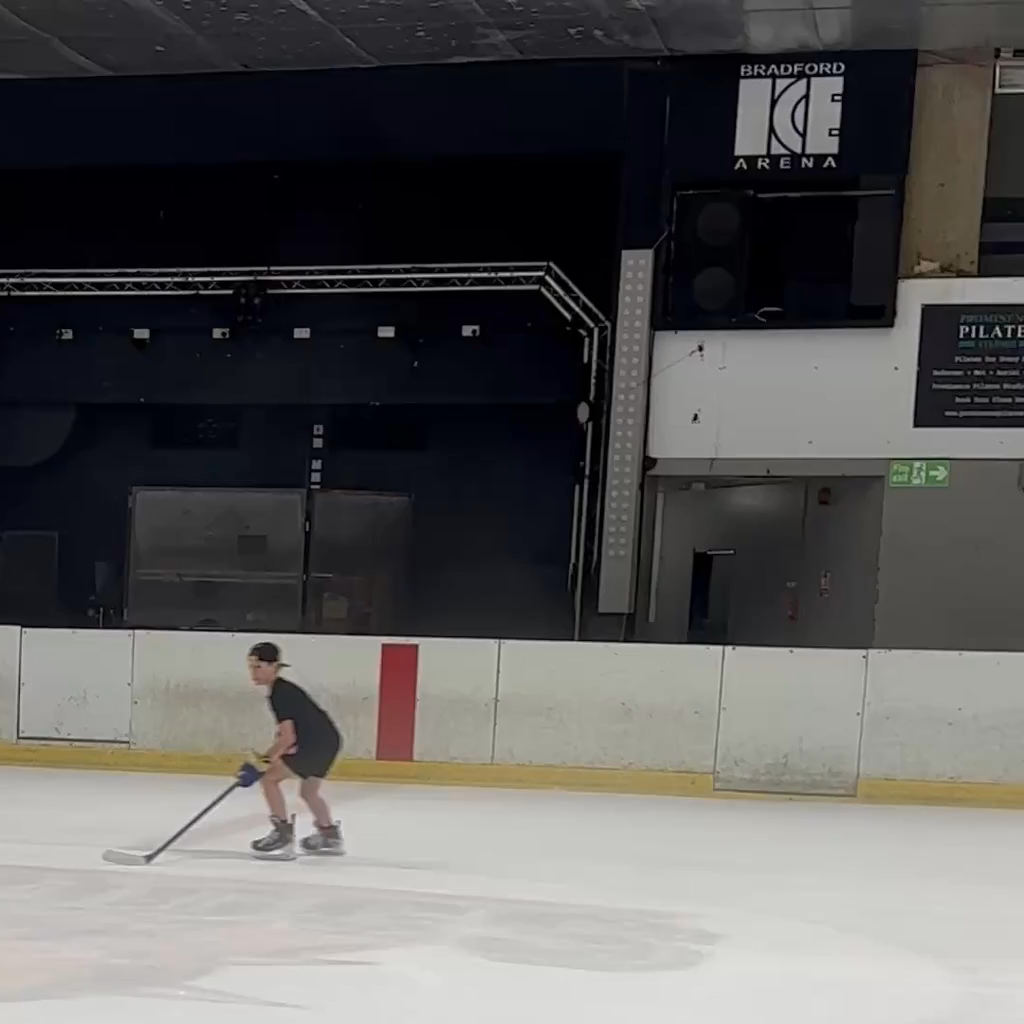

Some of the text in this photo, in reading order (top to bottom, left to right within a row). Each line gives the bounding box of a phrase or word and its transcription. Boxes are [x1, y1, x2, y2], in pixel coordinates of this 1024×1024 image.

[740, 62, 845, 76] BRADFORD
[734, 76, 844, 156] ICE
[734, 157, 837, 170] ARENA
